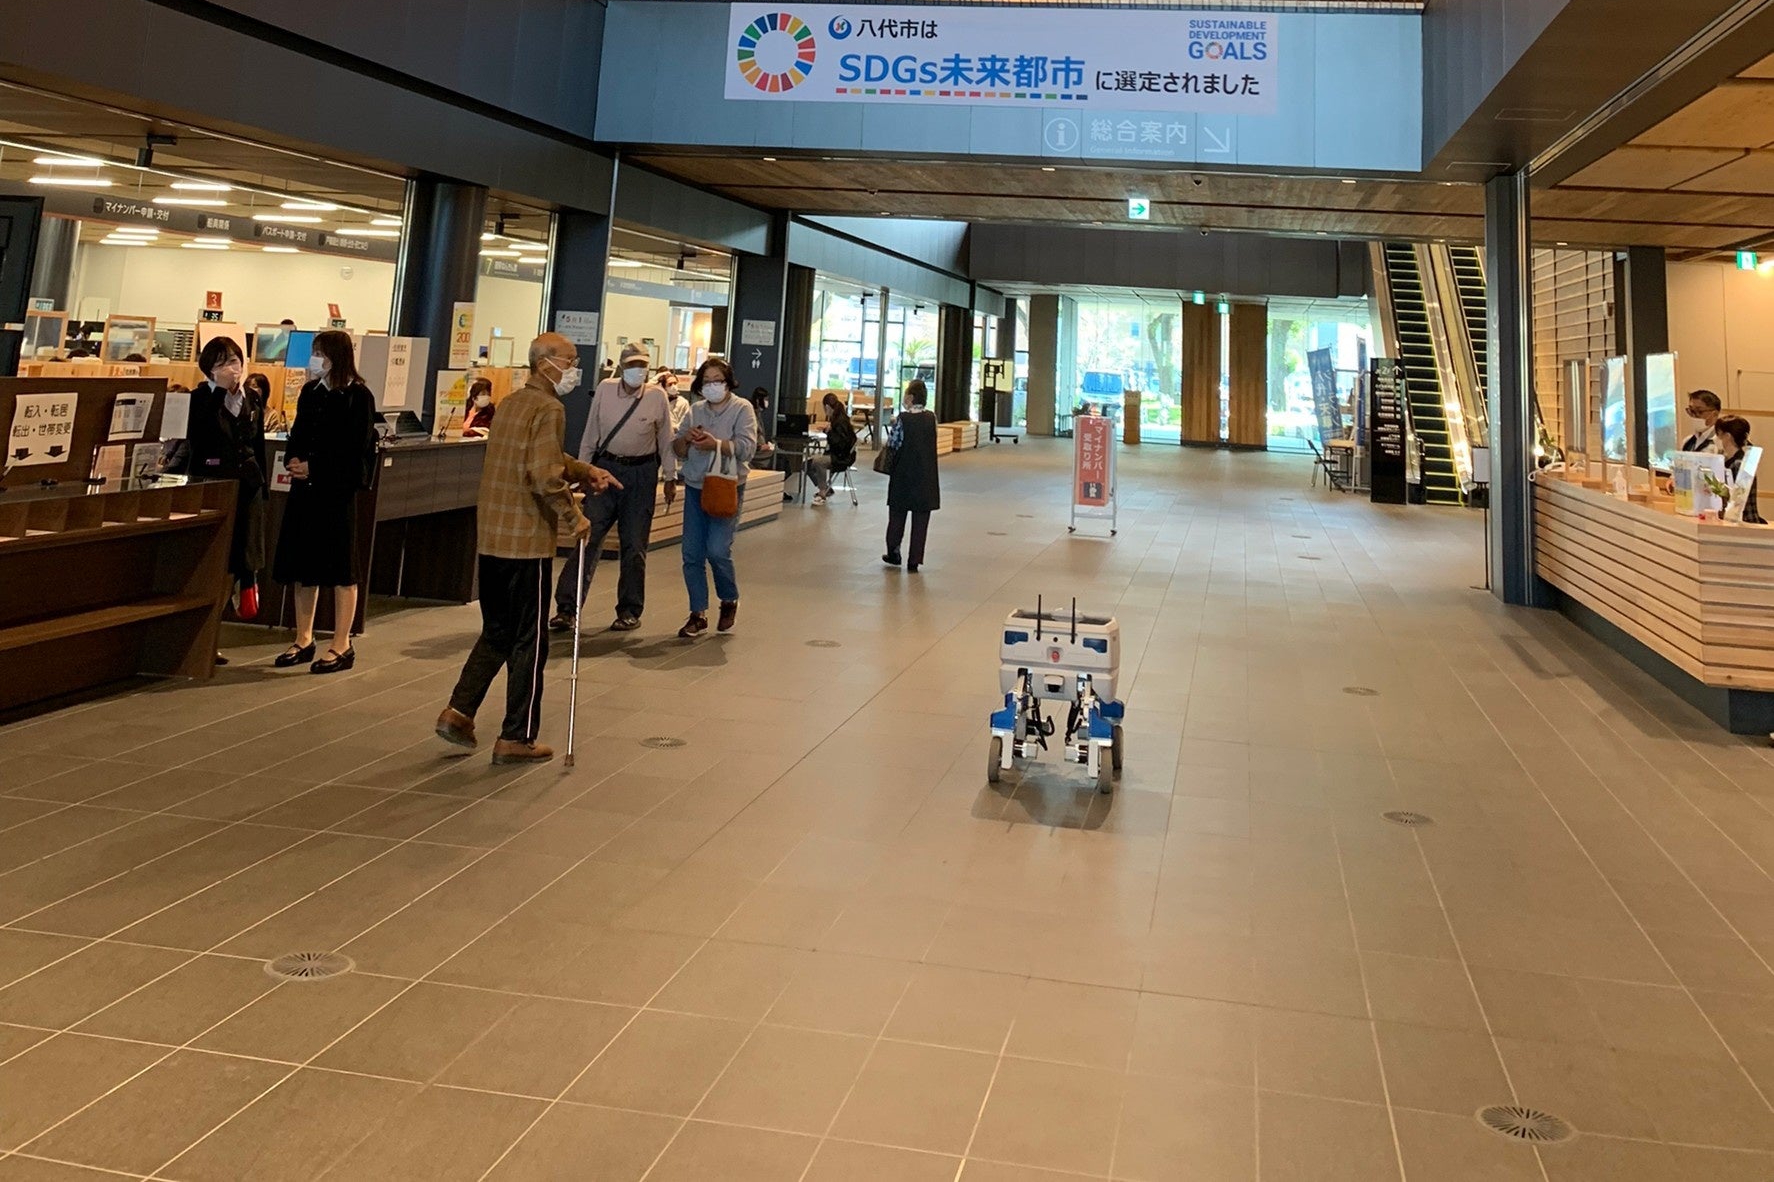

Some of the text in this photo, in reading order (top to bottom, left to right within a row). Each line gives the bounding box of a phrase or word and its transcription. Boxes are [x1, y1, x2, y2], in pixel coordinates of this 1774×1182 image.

[856, 18, 939, 39] 八代市は
[1189, 19, 1267, 30] SUSTAINABLE
[1189, 30, 1267, 41] DEVELOPMENT
[1188, 41, 1268, 61] GOALS
[838, 53, 1260, 96] SDGs未来都市 に選定されました
[1089, 117, 1188, 145] 総合案内
[211, 293, 218, 307] 3
[24, 403, 69, 419] 転入・転居
[12, 421, 72, 438] 転出・世帯変更
